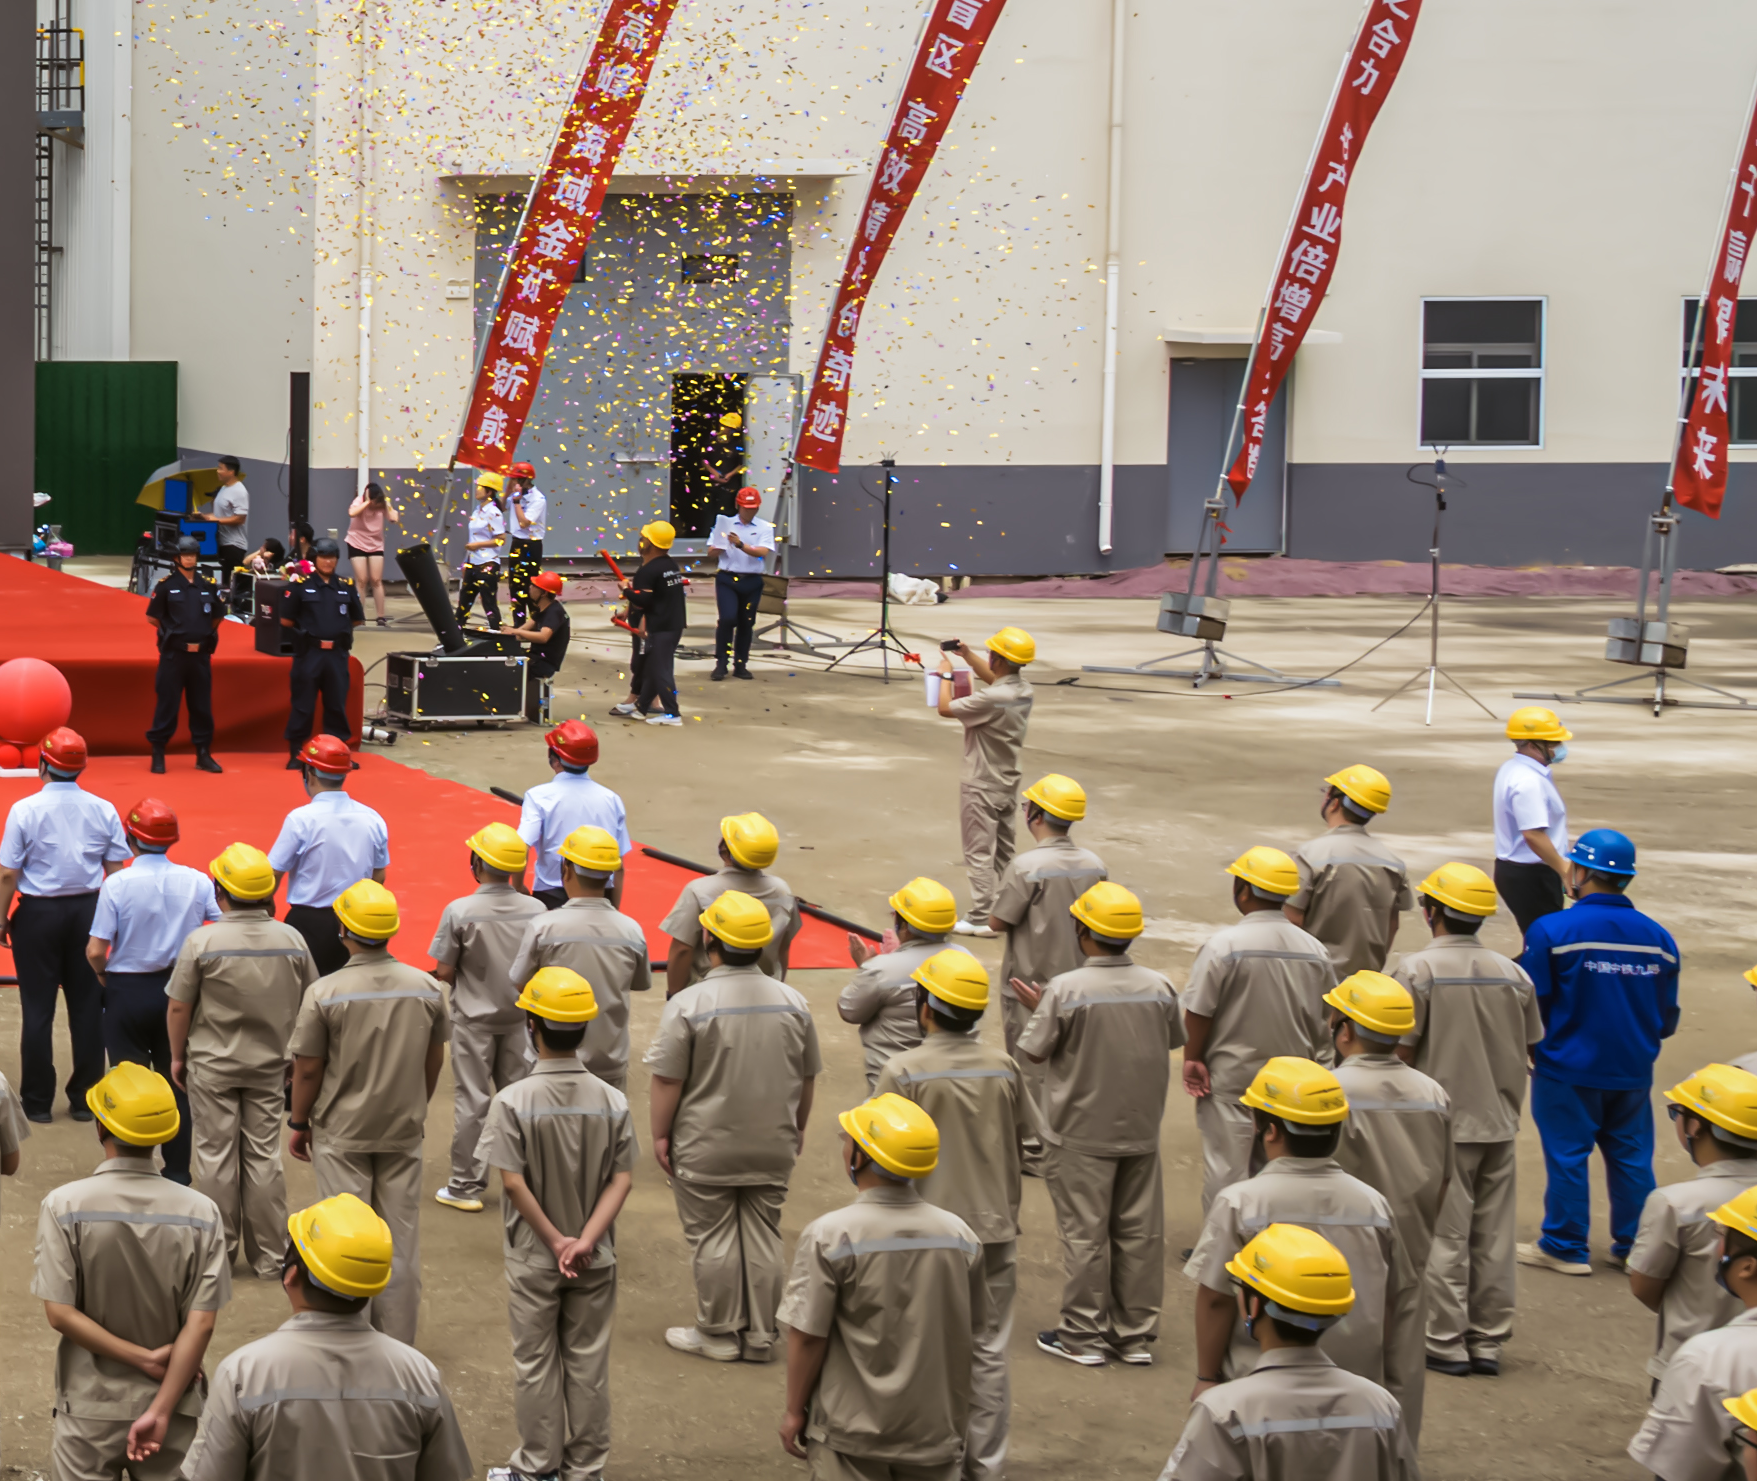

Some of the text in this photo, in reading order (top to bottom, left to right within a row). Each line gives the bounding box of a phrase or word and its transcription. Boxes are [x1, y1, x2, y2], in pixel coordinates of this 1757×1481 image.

[473, 122, 612, 449] 海域金矿赋新能
